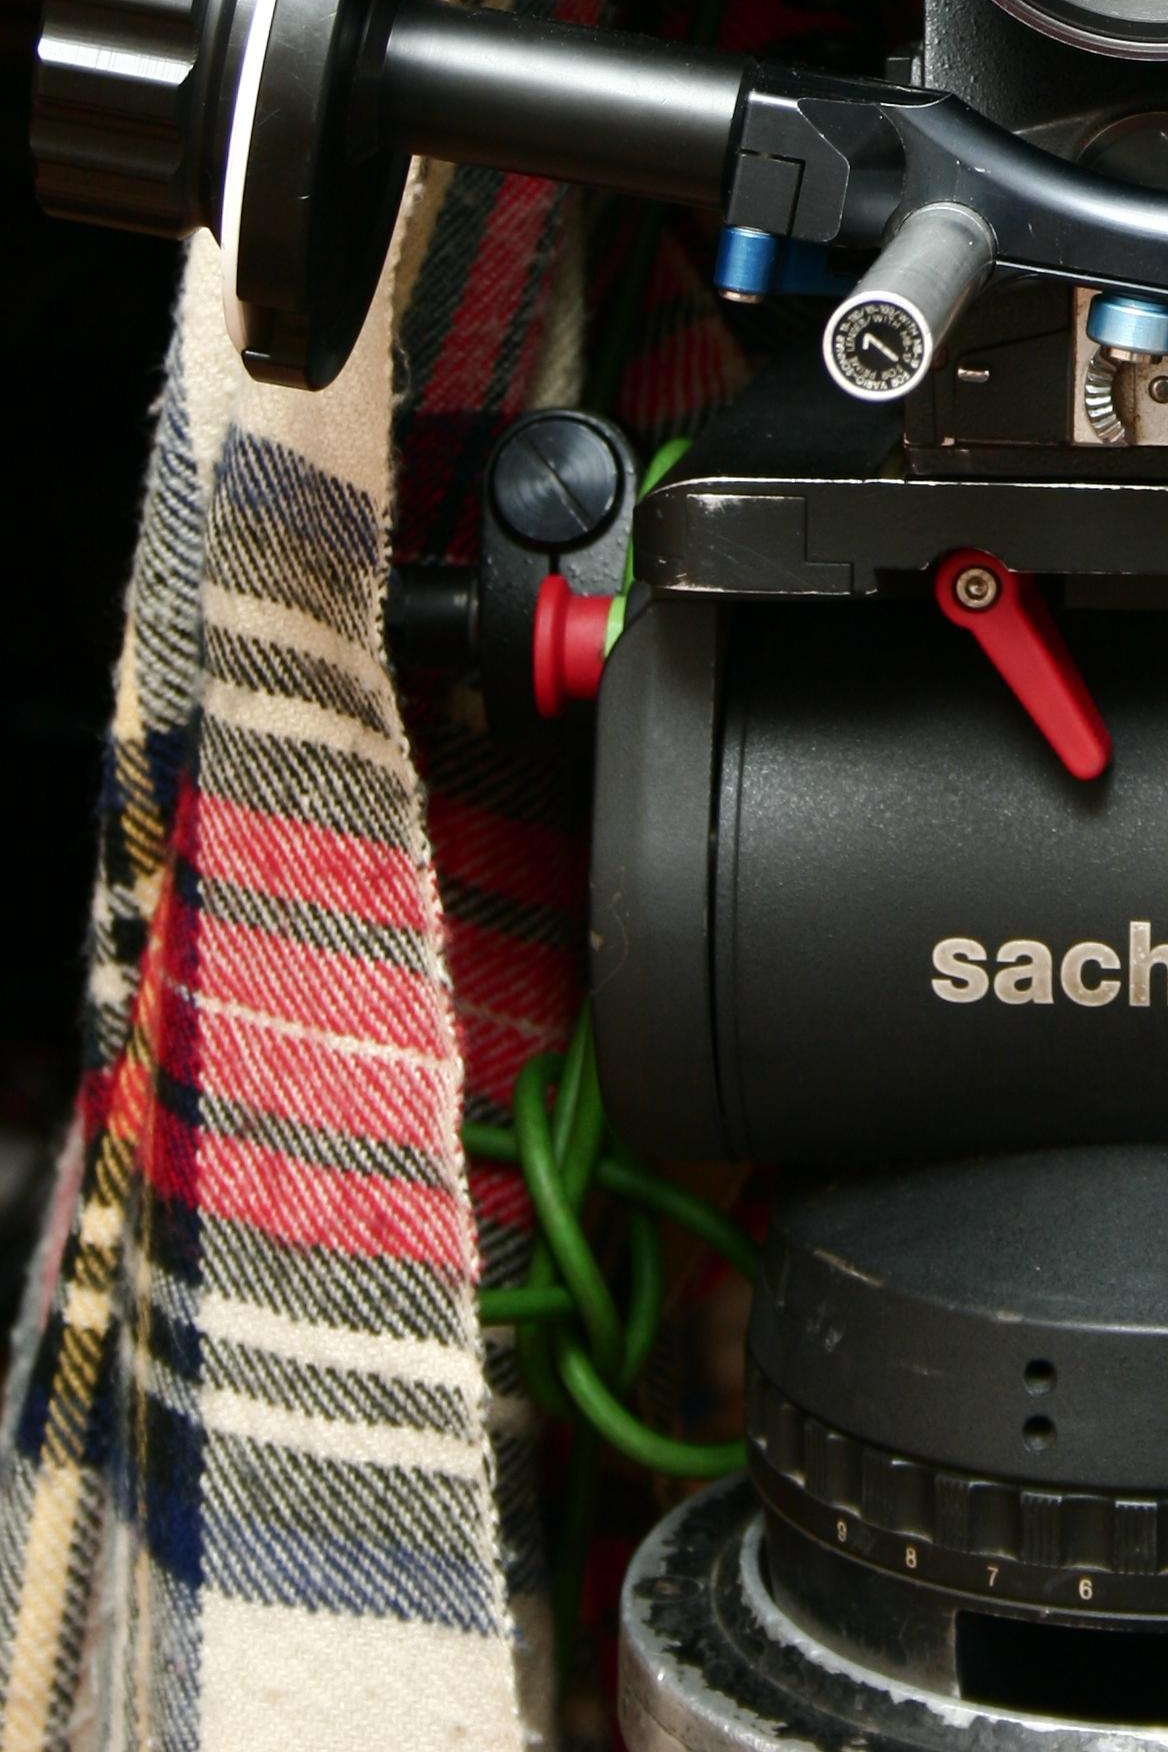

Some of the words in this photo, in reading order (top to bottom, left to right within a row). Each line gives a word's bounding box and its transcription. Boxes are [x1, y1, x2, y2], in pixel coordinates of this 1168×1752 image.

[836, 1520, 848, 1543] 9
[905, 1547, 917, 1569] 8
[987, 1565, 999, 1587] 7
[1078, 1578, 1093, 1600] 6
